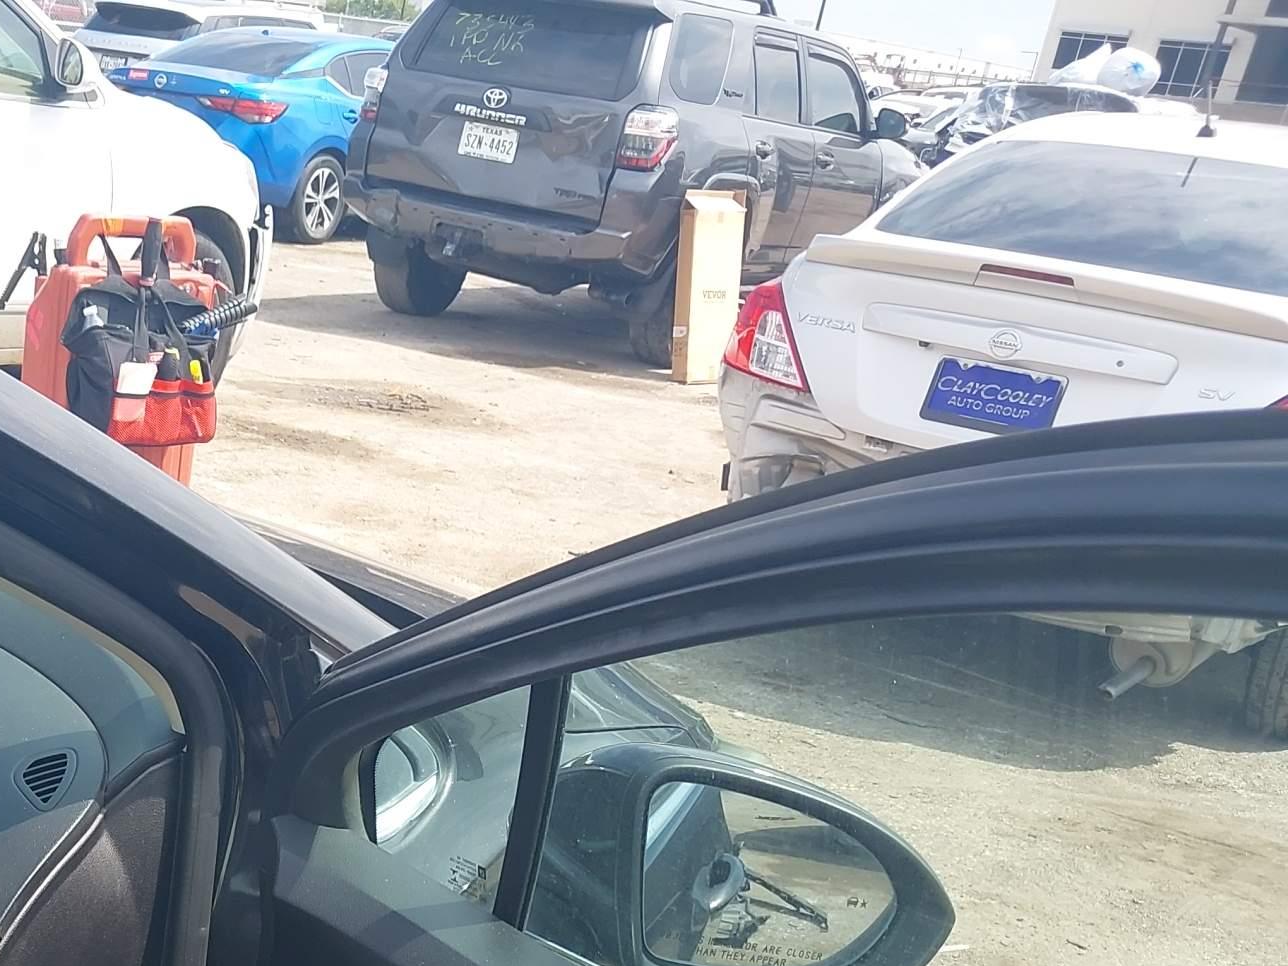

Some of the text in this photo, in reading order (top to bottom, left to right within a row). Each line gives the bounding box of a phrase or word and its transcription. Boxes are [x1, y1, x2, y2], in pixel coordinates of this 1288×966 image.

[454, 102, 527, 126] 4RUNNER
[482, 126, 503, 137] TEXAS
[703, 288, 727, 300] VEVOR
[797, 311, 856, 334] VERSA
[991, 338, 1019, 350] NISSAN
[1198, 386, 1238, 402] SV
[947, 395, 1031, 420] AUTO GROUP
[721, 949, 746, 962] THEY
[749, 953, 788, 966] APPEAR
[762, 944, 783, 956] ARE
[786, 947, 824, 961] CLOSER
